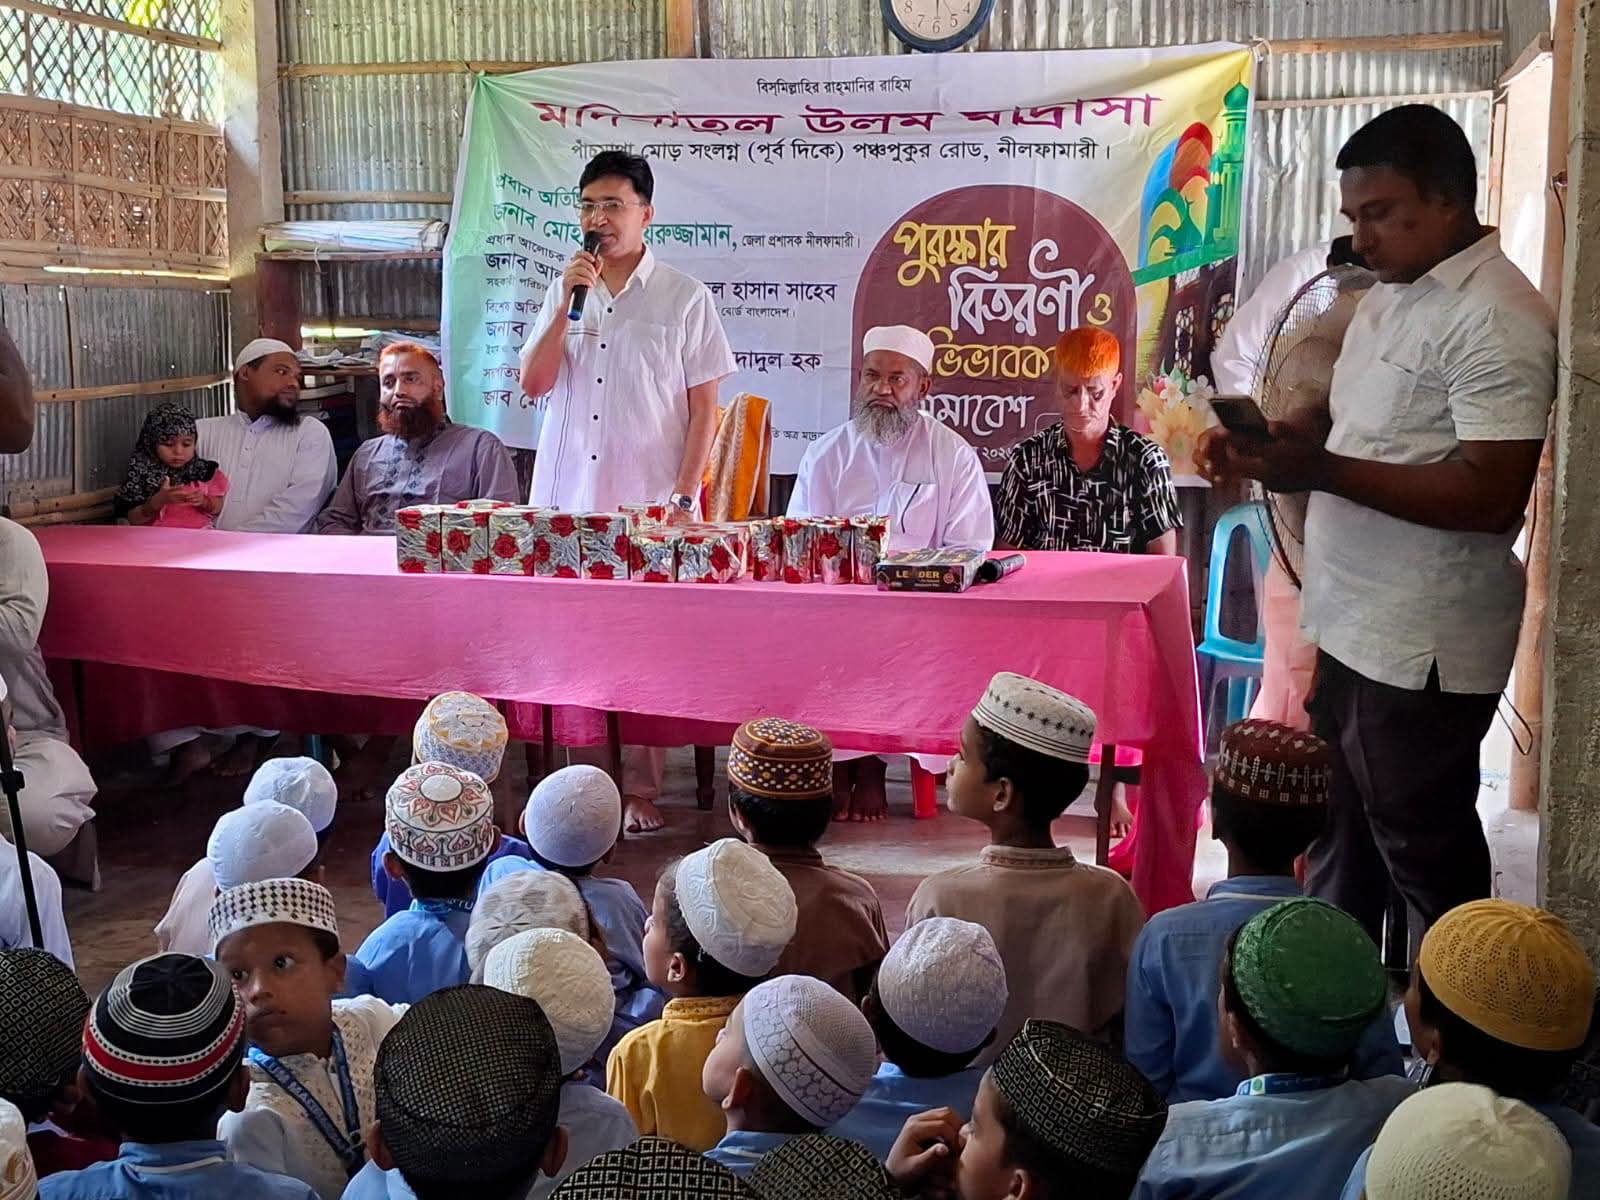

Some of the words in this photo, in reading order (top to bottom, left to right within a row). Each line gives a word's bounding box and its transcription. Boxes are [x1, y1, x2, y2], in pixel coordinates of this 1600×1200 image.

[932, 20, 940, 33] 6
[879, 76, 912, 92] রাহিম
[641, 142, 682, 161] মোড়
[688, 142, 740, 161] সংলগ্ন
[748, 137, 786, 163] (পূর্ব
[791, 138, 843, 163] দিকে)
[852, 142, 931, 163] পঞ্চপুকুর
[940, 141, 988, 162] রোড,
[893, 217, 1016, 286] পুরস্কার
[732, 280, 781, 301] হাসান
[785, 282, 838, 302] সাহেব
[947, 238, 1095, 336] বিতরণী
[1086, 293, 1112, 325] ও
[792, 352, 823, 373] হক
[926, 326, 1053, 378] ভিভাবক
[920, 394, 1035, 436] মাবেশ
